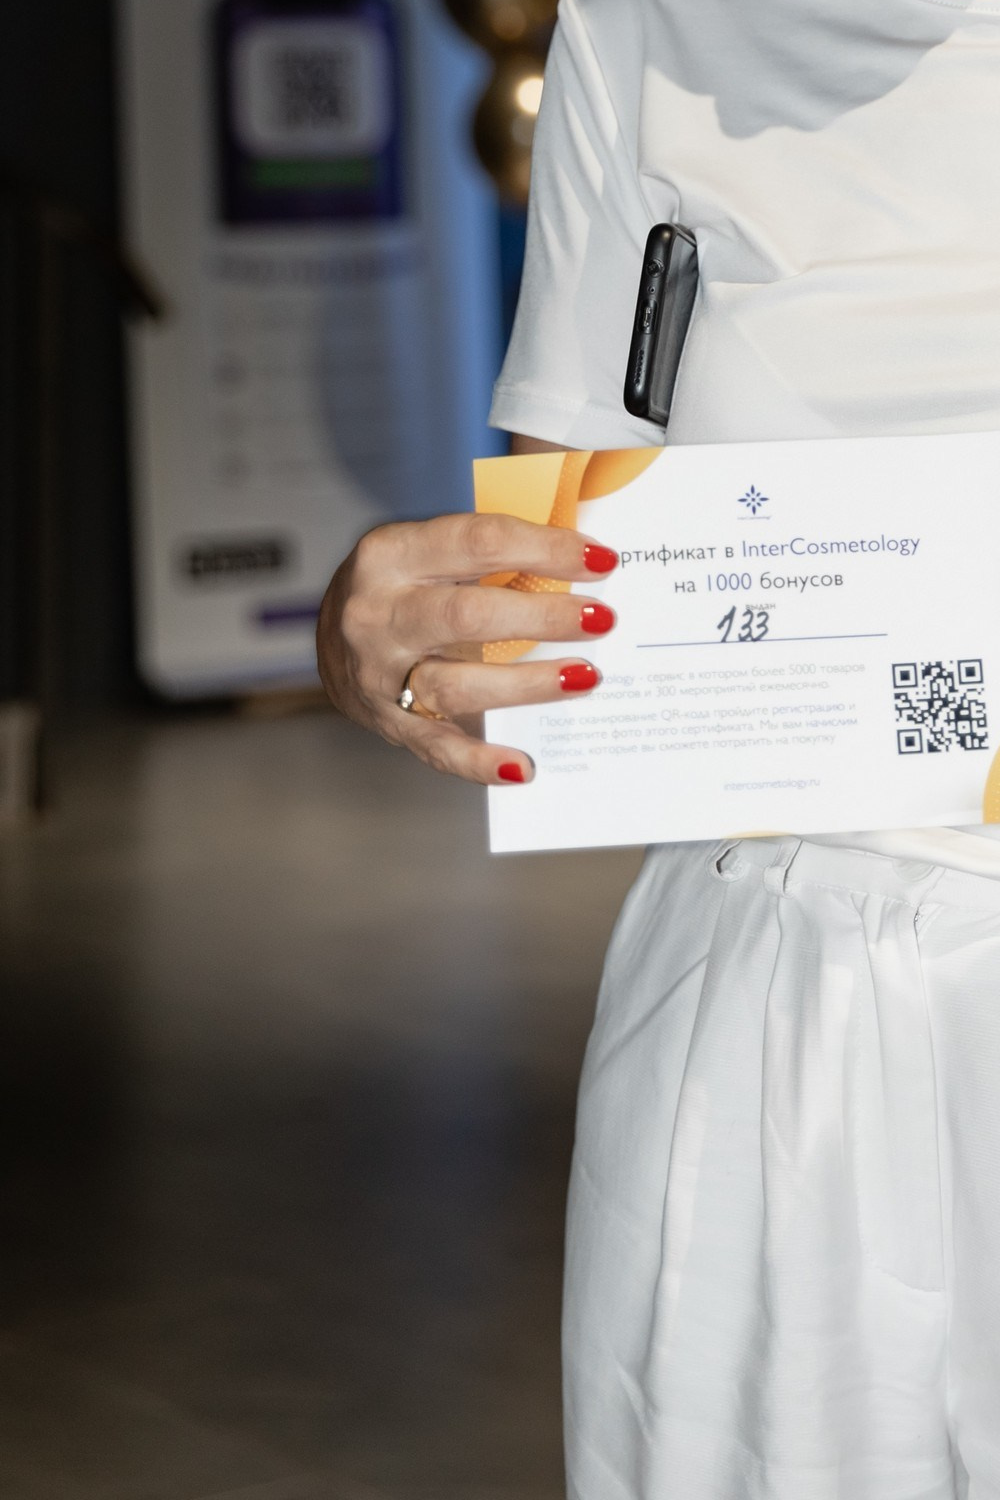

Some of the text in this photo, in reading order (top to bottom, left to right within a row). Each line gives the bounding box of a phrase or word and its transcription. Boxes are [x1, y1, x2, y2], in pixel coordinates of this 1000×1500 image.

[620, 534, 920, 568] ртификат в InterCosmetology
[674, 571, 843, 593] на 1000 бонусов
[717, 605, 769, 643] 133
[647, 673, 685, 683] сервис
[698, 670, 747, 680] котором
[751, 666, 785, 676] более
[789, 663, 816, 675] 5000
[820, 664, 865, 675] товаров
[656, 685, 676, 697] 300
[680, 682, 755, 696] мероприятий
[539, 715, 575, 727] После
[611, 728, 642, 741] фото
[646, 726, 678, 736] этого
[760, 718, 779, 730] Мы
[782, 721, 802, 730] вам
[589, 744, 637, 756] которые
[659, 740, 709, 751] сможете
[712, 738, 773, 749] потратить
[724, 778, 820, 790] intercosmetology.ru
